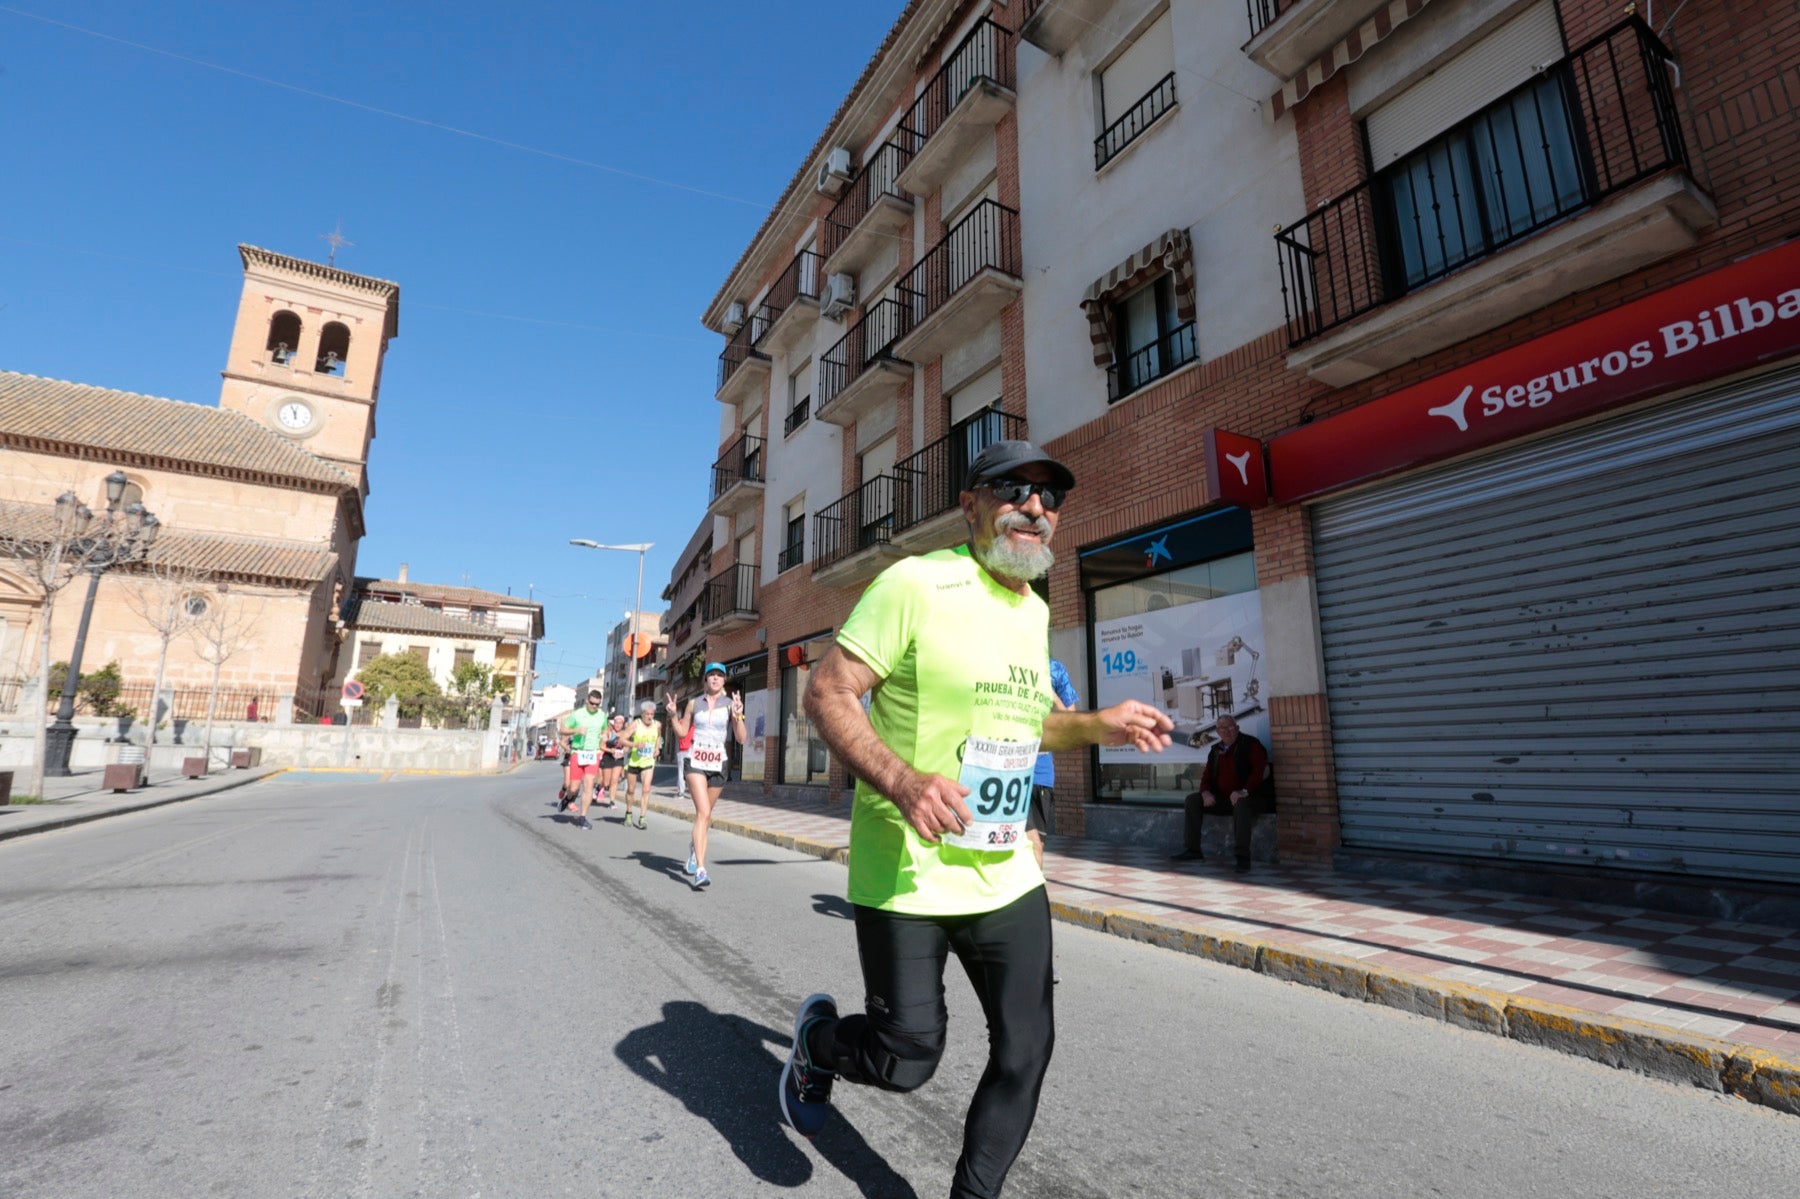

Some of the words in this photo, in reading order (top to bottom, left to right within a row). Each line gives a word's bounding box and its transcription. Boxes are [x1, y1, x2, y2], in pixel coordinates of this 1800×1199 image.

[1481, 341, 1654, 416] Seguros
[1102, 650, 1136, 675] 149
[1008, 664, 1039, 688] XXV
[975, 682, 1013, 696] PRUEBA
[1017, 687, 1030, 699] DE
[694, 750, 721, 763] 2004
